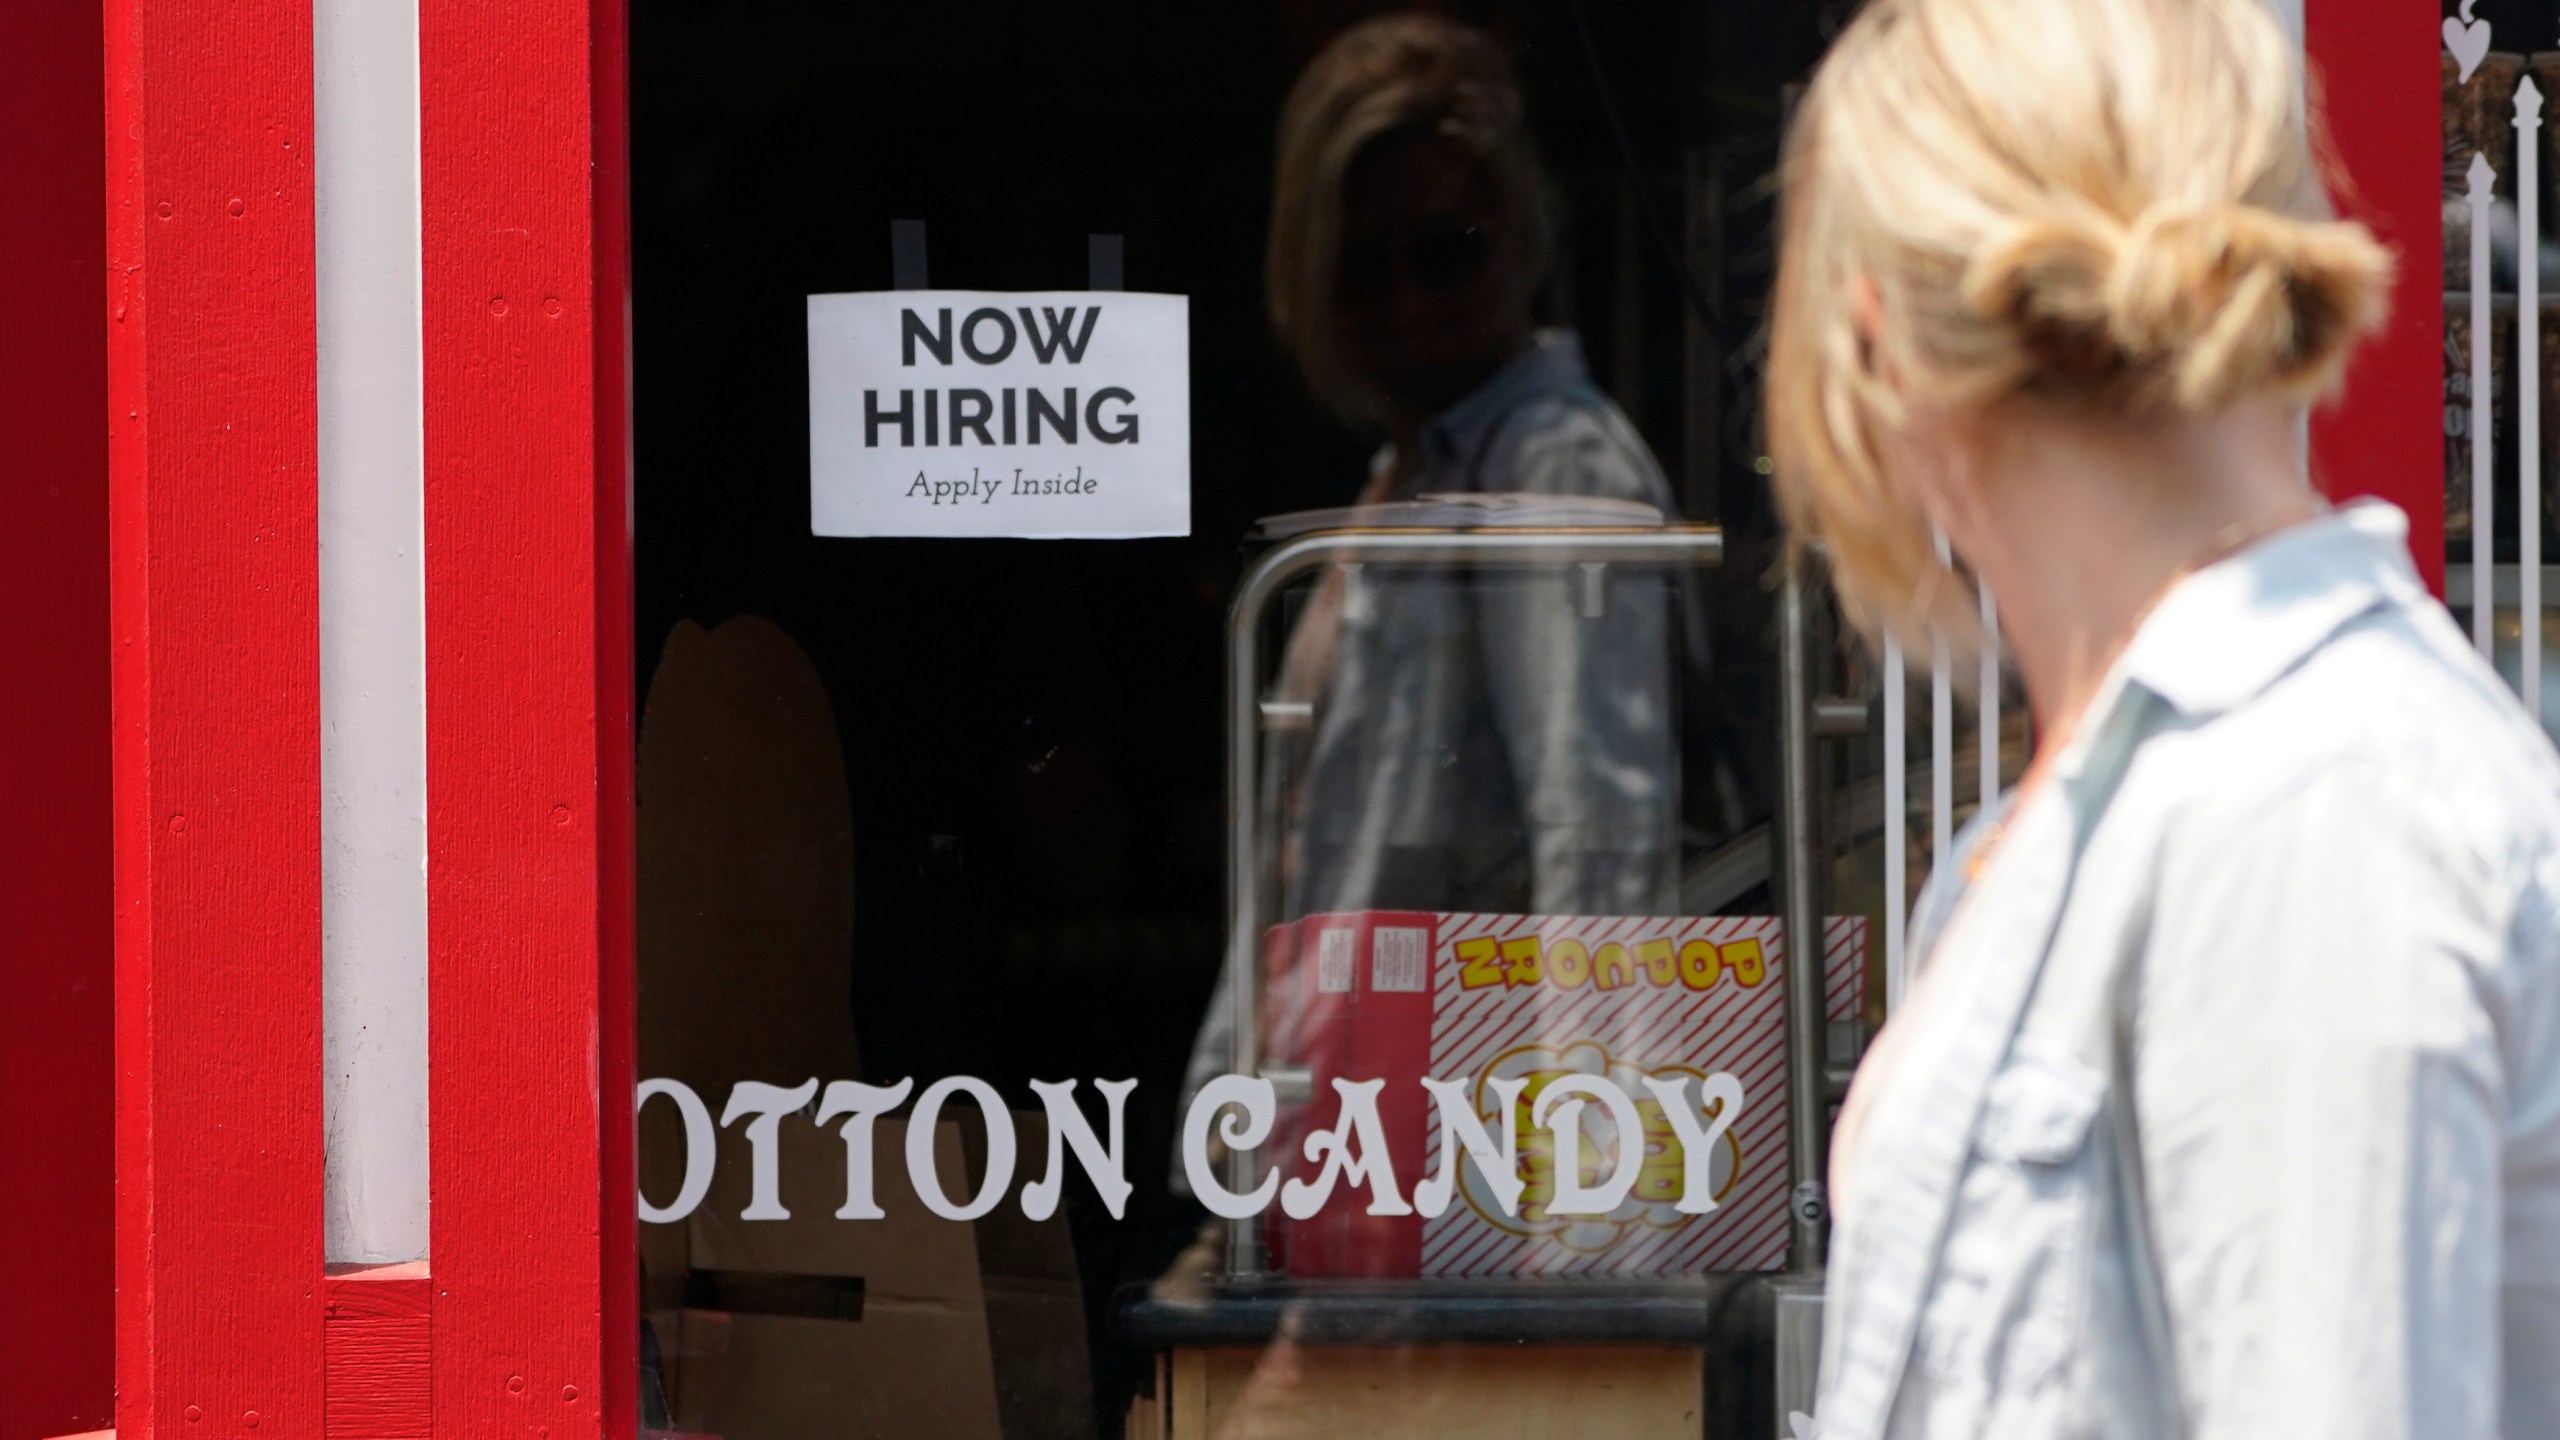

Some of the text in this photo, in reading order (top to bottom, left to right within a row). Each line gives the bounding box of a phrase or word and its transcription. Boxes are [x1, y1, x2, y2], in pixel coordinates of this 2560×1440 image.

[901, 306, 1102, 367] NOW
[863, 386, 1139, 448] HIRING
[905, 466, 1098, 506] Apply Inside
[1452, 933, 1767, 992] POPCORN
[1183, 1071, 1744, 1220] CANDY
